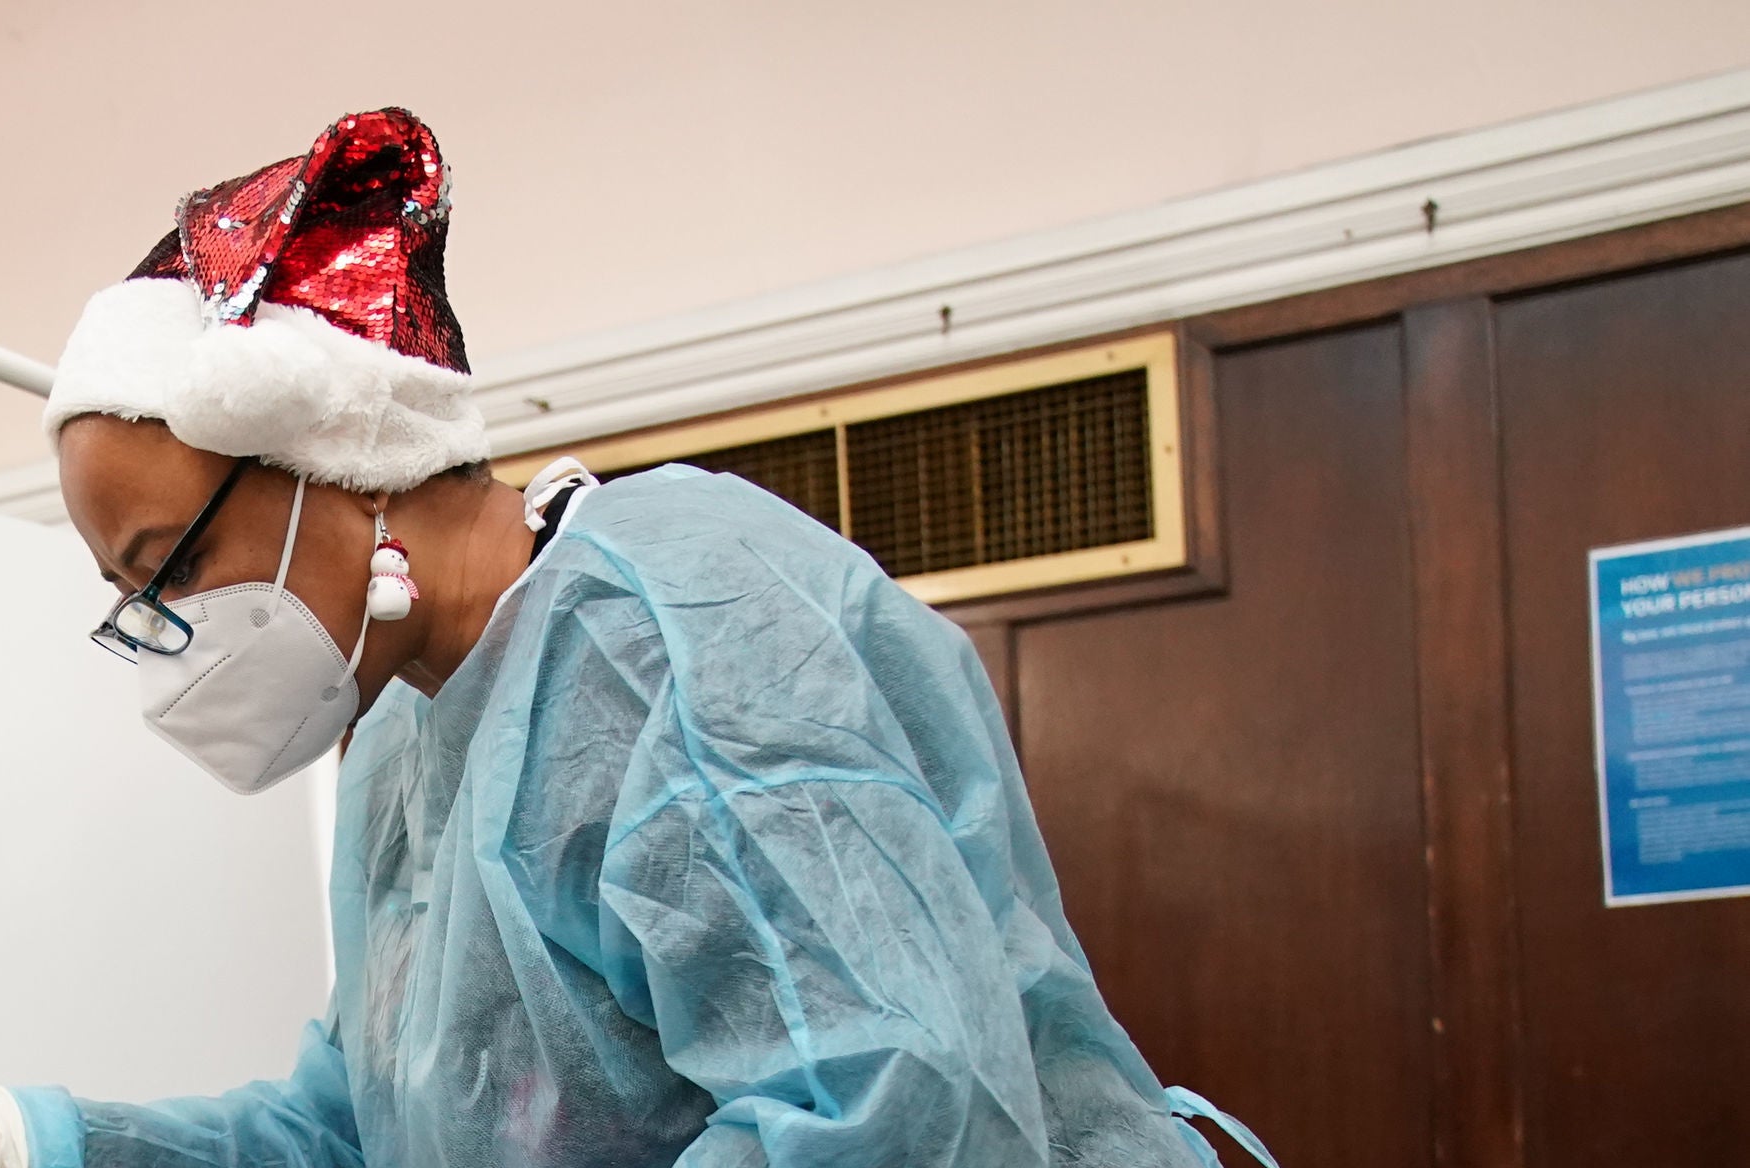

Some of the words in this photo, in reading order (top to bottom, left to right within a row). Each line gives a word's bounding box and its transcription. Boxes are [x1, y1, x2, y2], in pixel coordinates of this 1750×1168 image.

[1621, 574, 1670, 596] HOW
[1674, 570, 1703, 587] WE
[1621, 594, 1675, 618] YOUR
